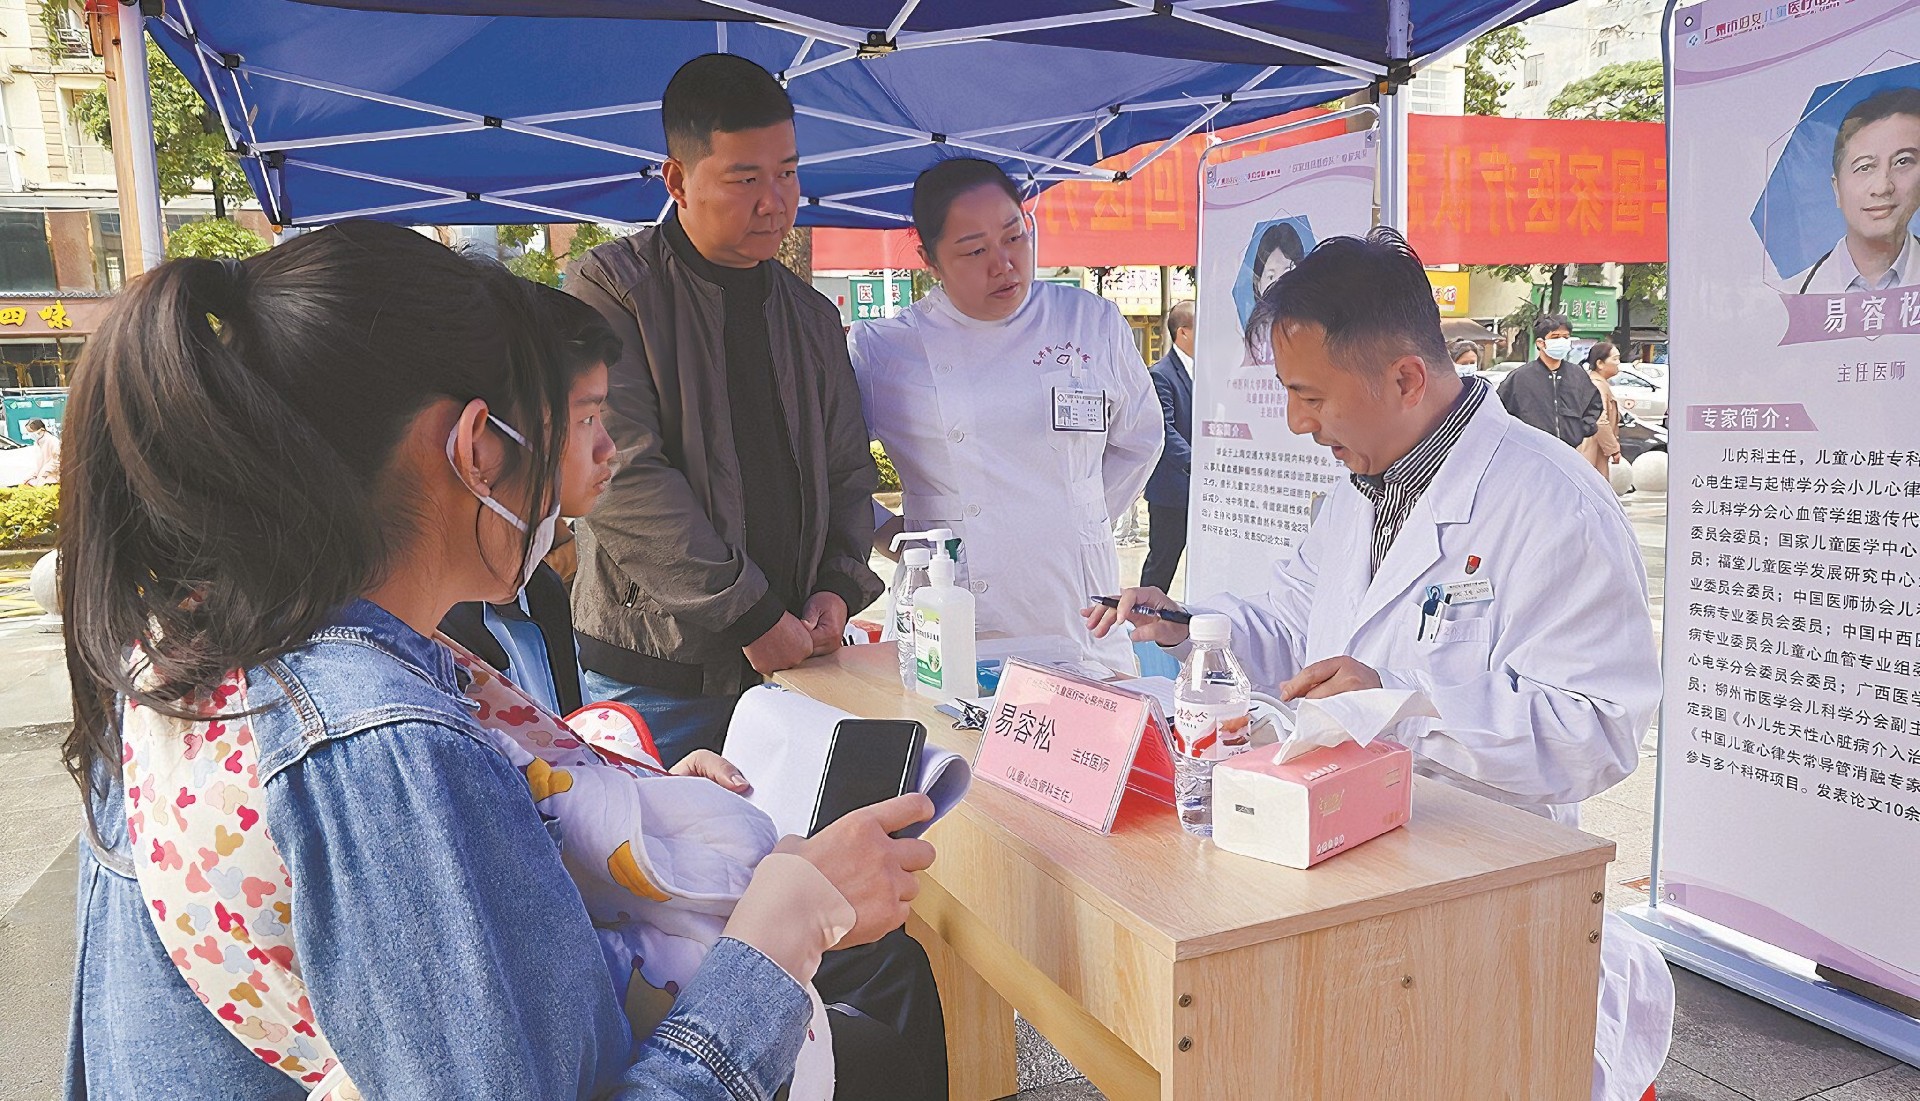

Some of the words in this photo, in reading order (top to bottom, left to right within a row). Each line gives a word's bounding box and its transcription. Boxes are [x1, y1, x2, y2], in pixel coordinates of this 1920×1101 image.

[1704, 0, 1839, 40] 广州市妇女儿童医疗
[1823, 291, 1920, 333] 易容松
[1837, 360, 1906, 383] 主任医师
[1700, 406, 1790, 429] 专家简介：
[1721, 448, 1920, 468] 儿内科主任，儿童心脏专科
[1690, 499, 1920, 529] 会儿科学分会心血管学组遗传代
[1690, 525, 1918, 558] 委员会委员；国家儿童医学中心
[1690, 551, 1920, 588] 员；福堂儿童医学发展研究中心
[1689, 577, 1920, 617] 业委员会委员；中国医师协会儿
[1687, 676, 1920, 736] 员；柳州市医学会儿科学分会副主
[995, 702, 1056, 753] 易容松
[1687, 701, 1920, 764] 定我国《小儿先天性心脏病介入治
[1070, 747, 1111, 773] 主任医师
[1690, 726, 1920, 793] 《中国儿童心律失常导管消融专家
[1686, 750, 1920, 822] 参与多个科研项目。发表论文10余
